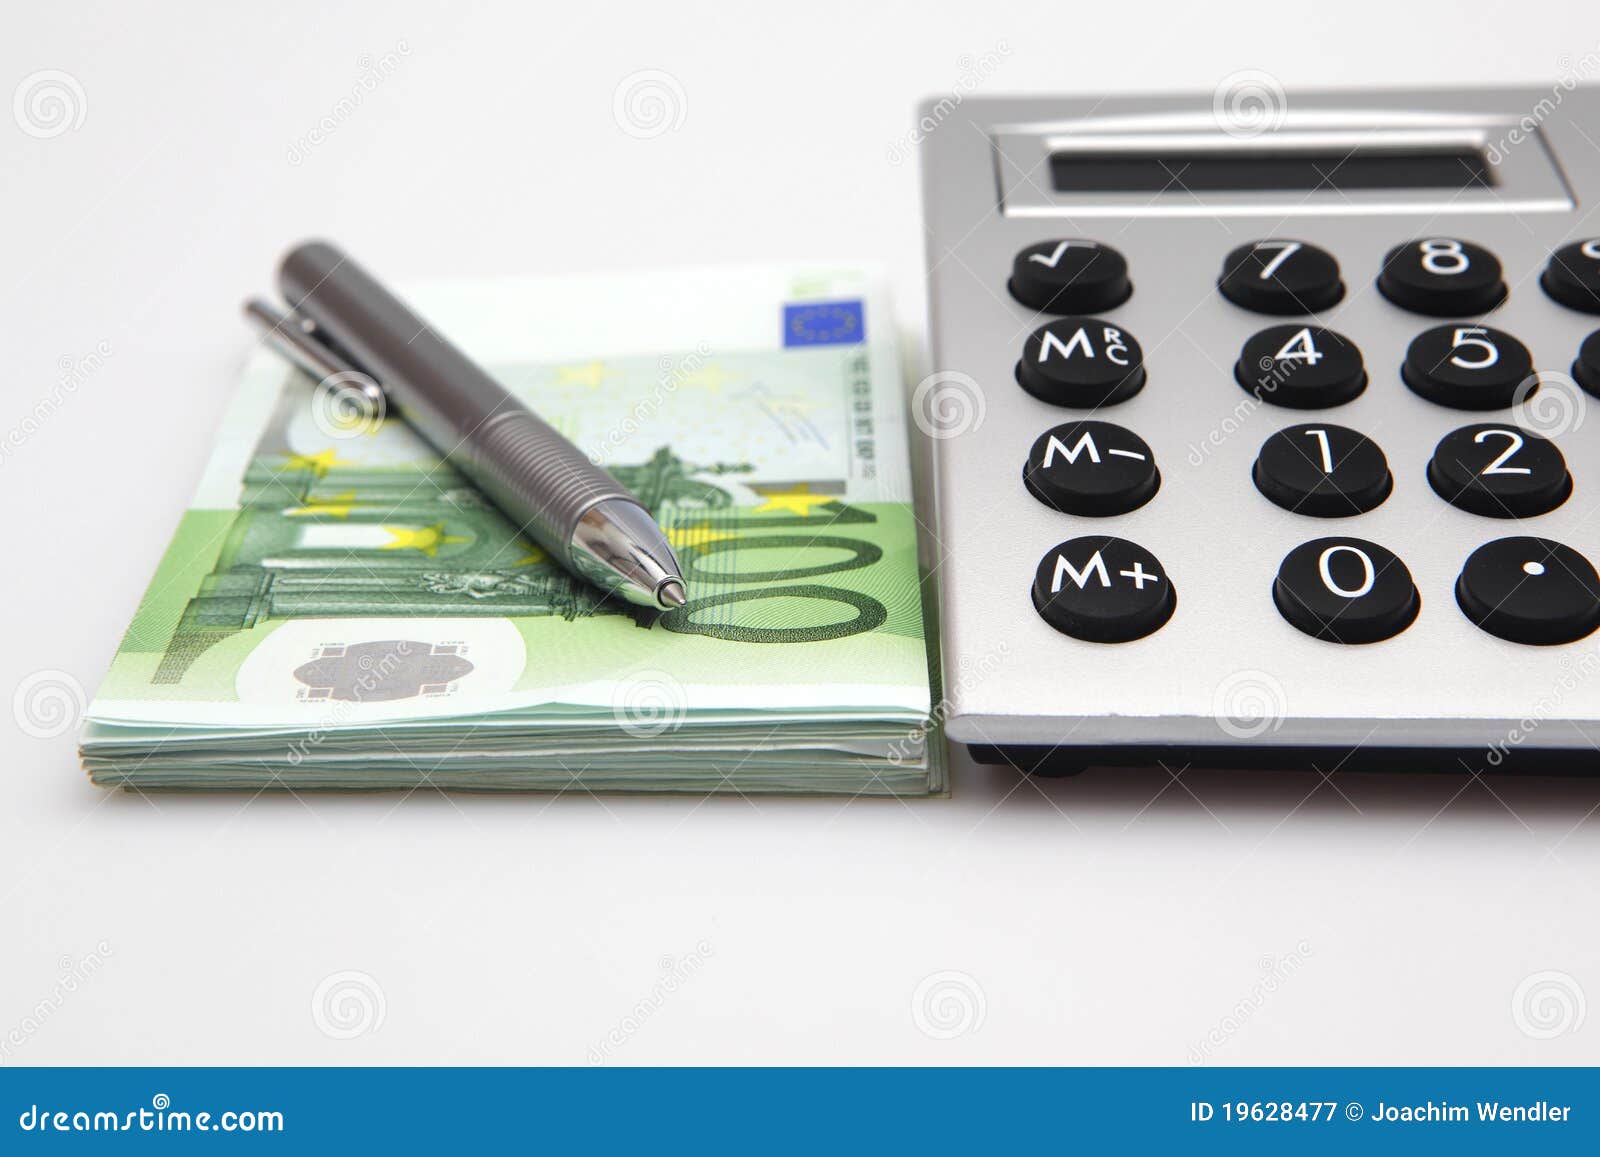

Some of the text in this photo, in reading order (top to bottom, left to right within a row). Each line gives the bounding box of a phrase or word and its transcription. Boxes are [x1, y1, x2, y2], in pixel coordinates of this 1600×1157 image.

[1254, 241, 1300, 279] 7
[1420, 239, 1470, 275] 8
[1274, 328, 1323, 366] 4
[1451, 328, 1498, 368] 5
[1305, 429, 1333, 474] 1
[1474, 429, 1531, 475] 2
[660, 499, 888, 643] 100
[1050, 550, 1159, 593] M+
